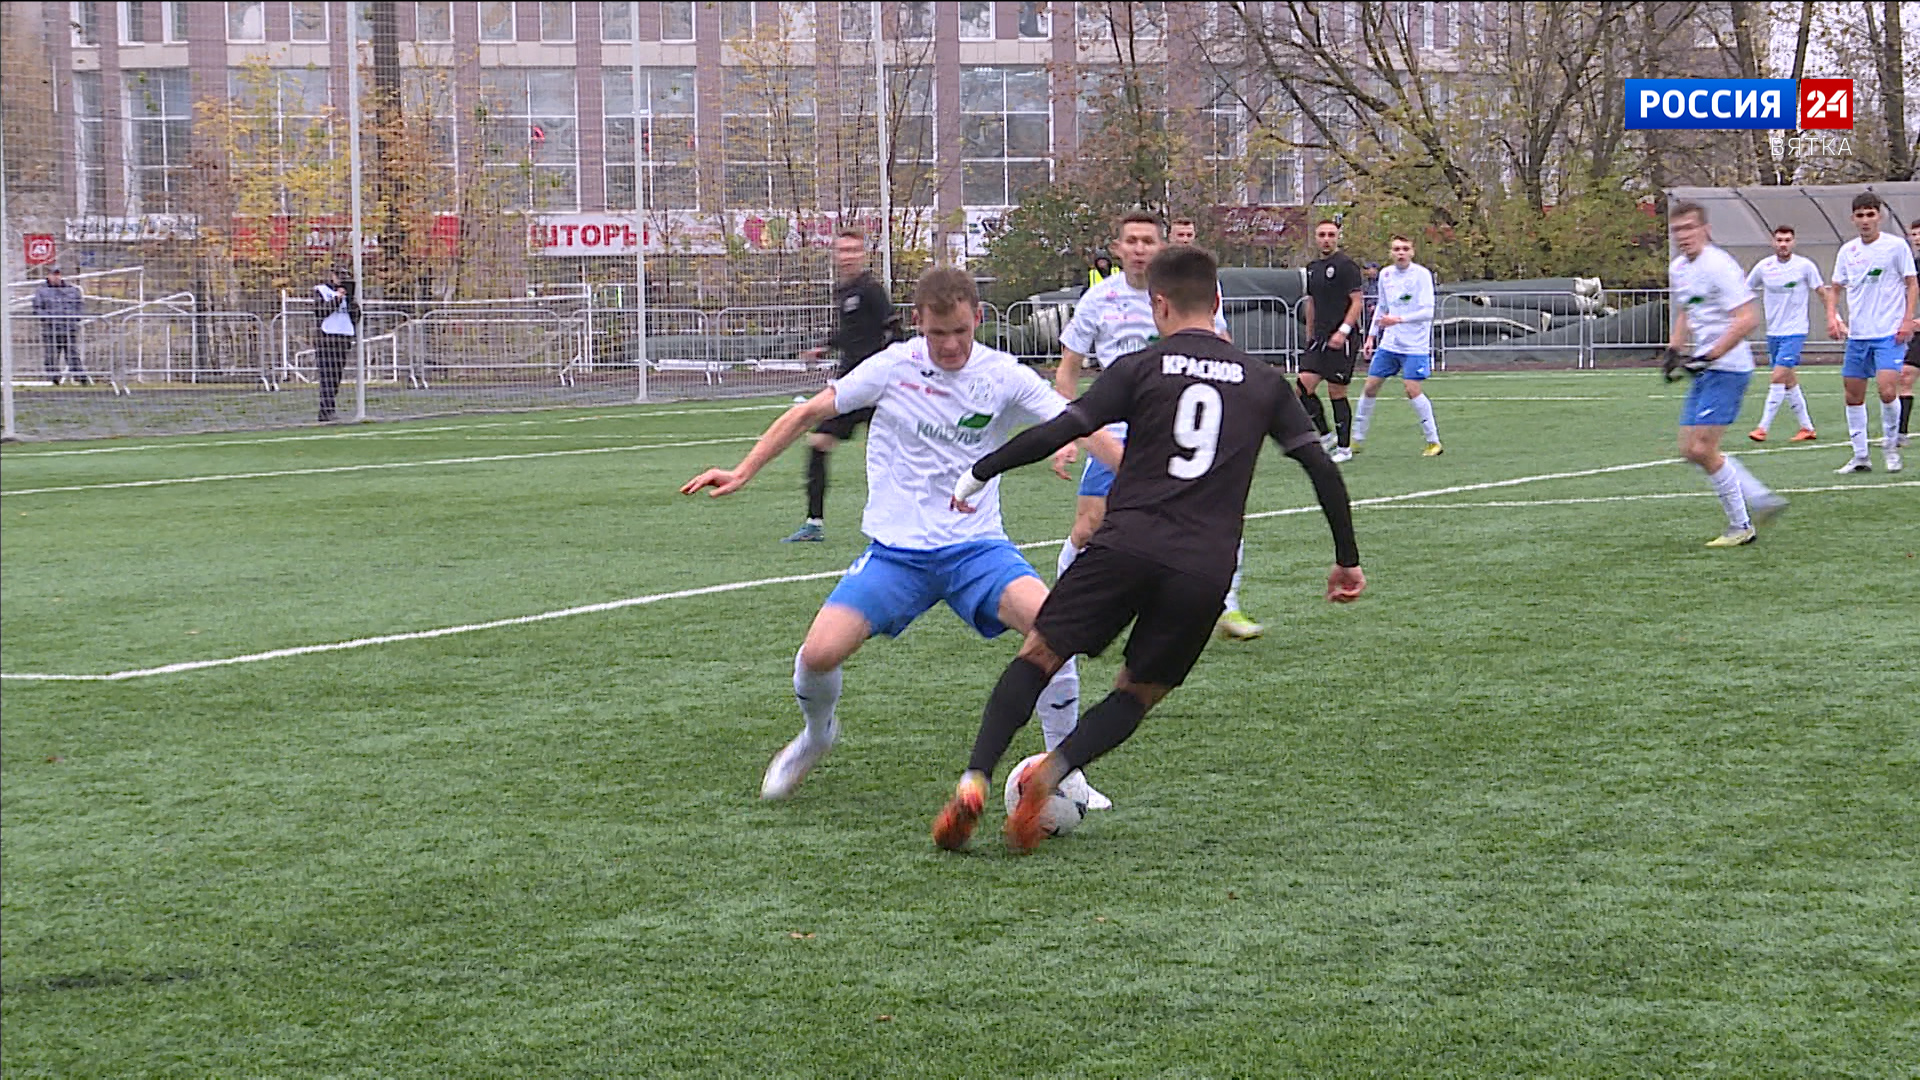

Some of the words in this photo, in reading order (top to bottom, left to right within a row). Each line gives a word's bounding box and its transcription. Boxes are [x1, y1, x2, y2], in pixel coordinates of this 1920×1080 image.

[530, 223, 650, 248] ШТОРЫ
[1161, 354, 1245, 384] КРАСНОВ
[1167, 382, 1223, 480] 9
